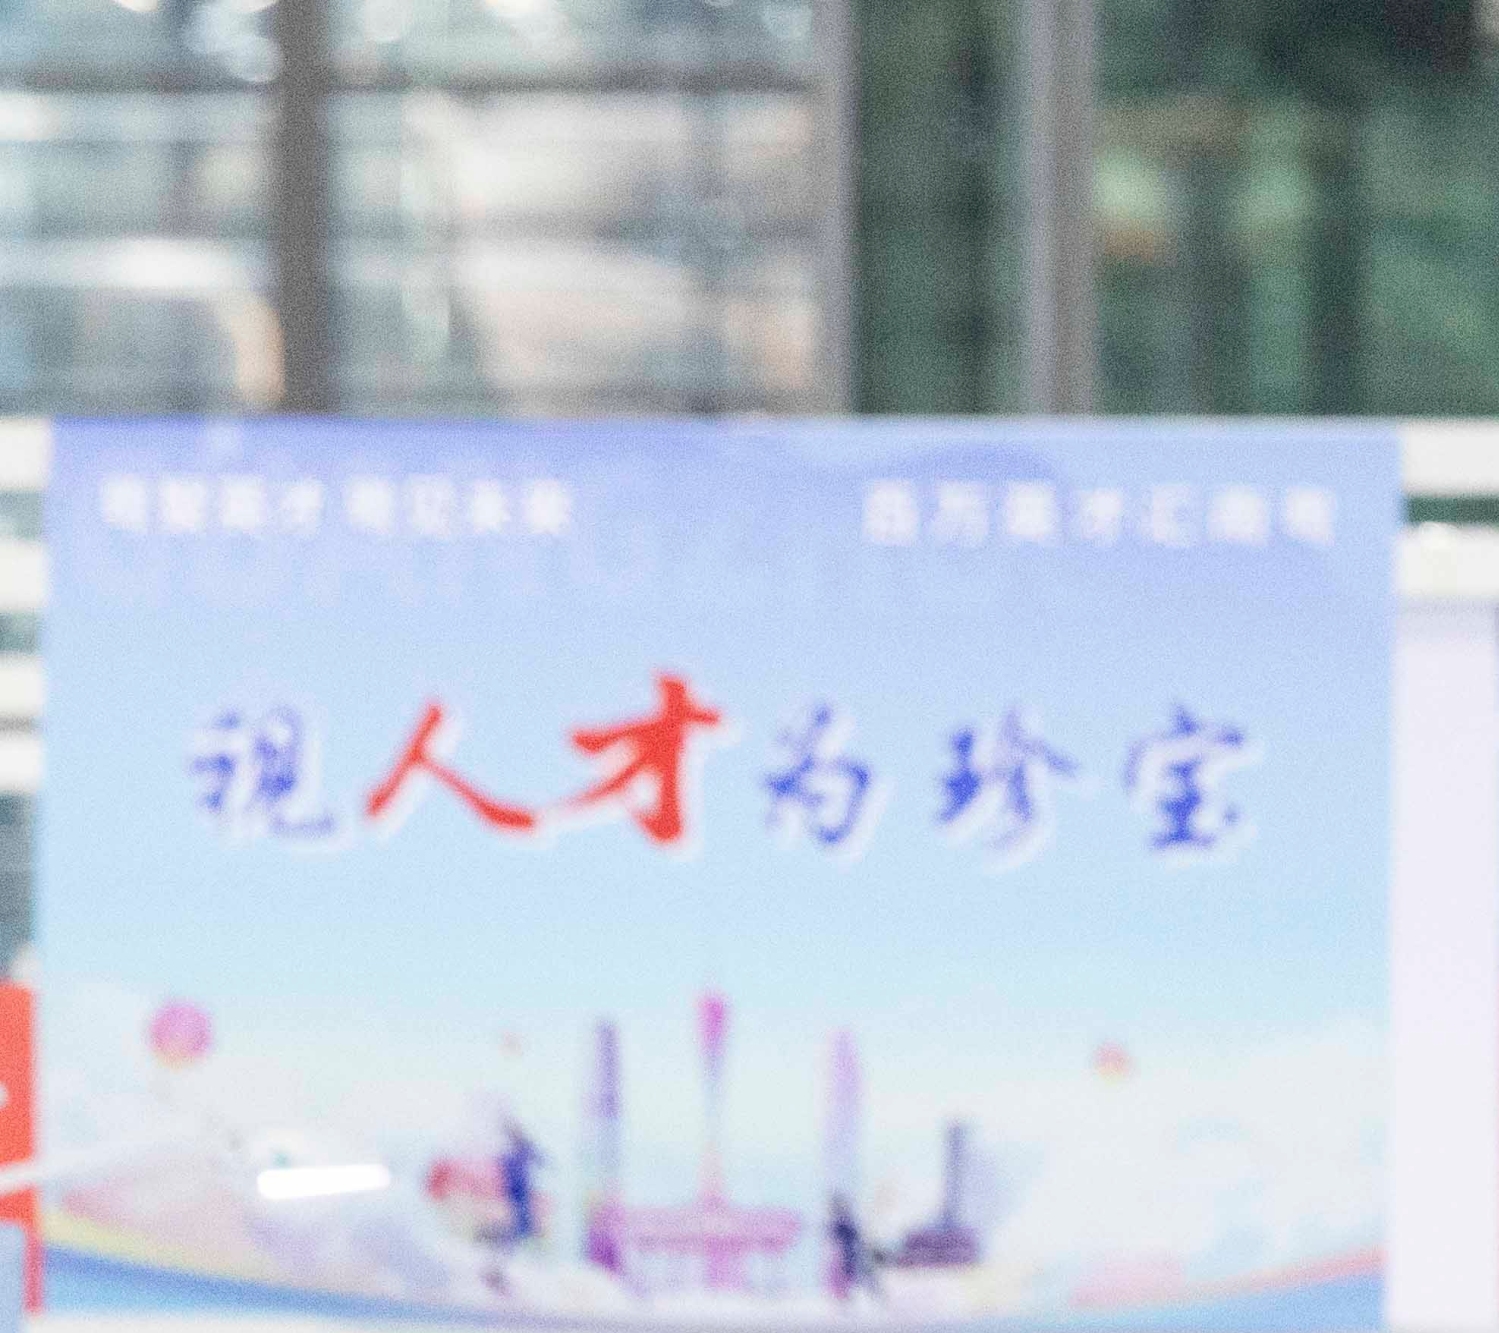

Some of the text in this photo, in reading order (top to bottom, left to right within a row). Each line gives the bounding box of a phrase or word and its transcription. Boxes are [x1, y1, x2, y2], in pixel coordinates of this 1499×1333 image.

[192, 672, 1252, 848] 视人才为珍宝
